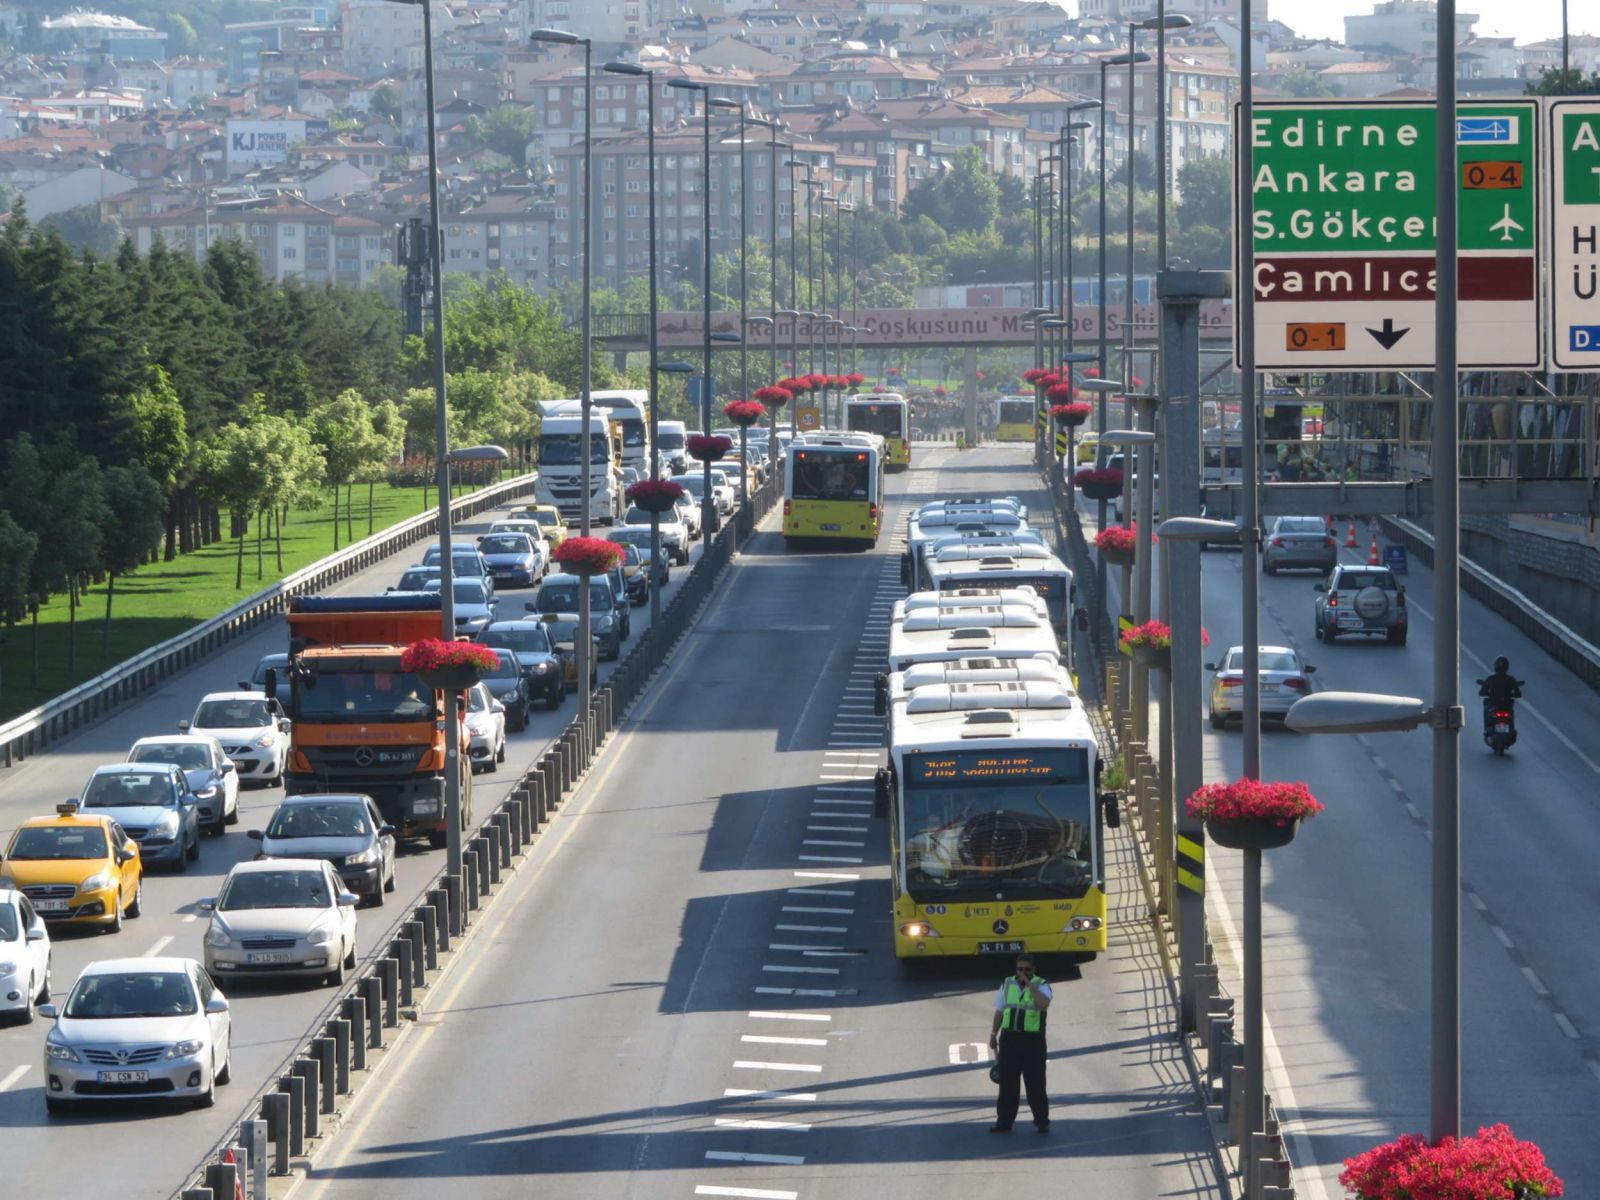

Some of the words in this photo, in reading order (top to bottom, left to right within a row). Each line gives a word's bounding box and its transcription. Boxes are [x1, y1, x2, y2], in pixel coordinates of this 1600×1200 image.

[233, 133, 255, 151] KJ
[1252, 118, 1418, 147] Edirne
[1253, 164, 1416, 193] Ankara
[1253, 209, 1437, 243] S.Gökçe
